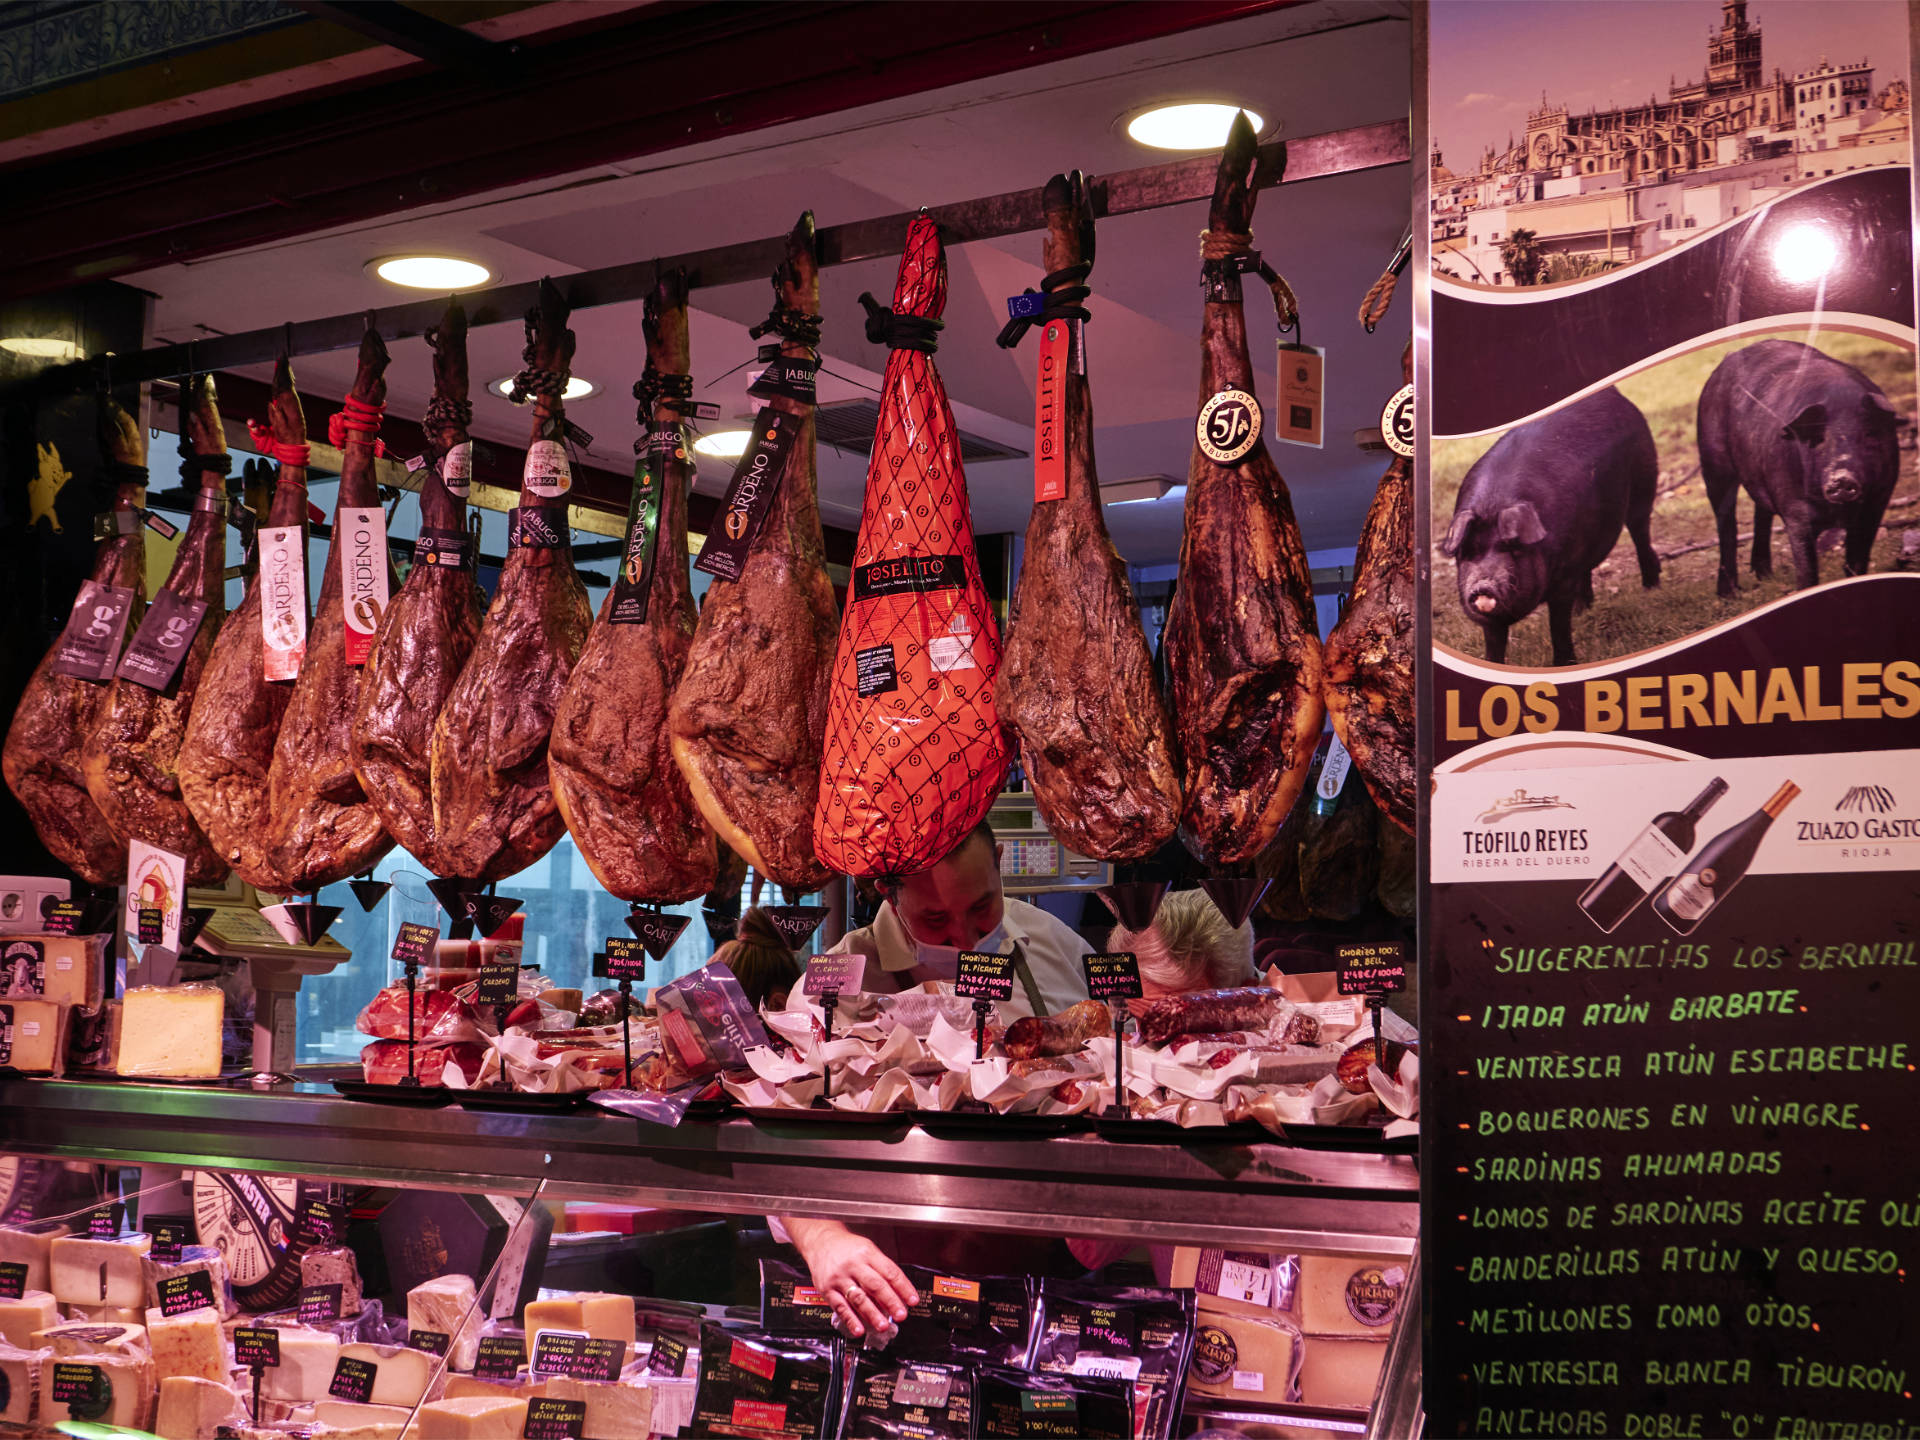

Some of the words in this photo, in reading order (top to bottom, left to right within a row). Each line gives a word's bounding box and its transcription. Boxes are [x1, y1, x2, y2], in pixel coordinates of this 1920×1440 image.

[1042, 355, 1054, 463] JOSELITO
[1200, 393, 1227, 426] CINCO
[1231, 391, 1258, 422] JOTAS
[1211, 406, 1245, 447] 5J
[1200, 436, 1239, 460] JABUGO
[728, 453, 769, 531] CARDENO
[523, 508, 560, 544] JABUGO
[627, 498, 649, 576] CARDENO
[354, 529, 375, 620] CARDENO
[866, 559, 945, 585] JOSELITO
[1445, 682, 1560, 742] LOS
[1584, 660, 1920, 733] BERNALES
[1463, 829, 1531, 854] TEÓFILO
[1536, 828, 1588, 851] REYES
[1797, 821, 1859, 840] ZUAZO
[1463, 858, 1509, 868] RIBERA
[1516, 857, 1540, 867] DEL
[1547, 855, 1591, 866] DUERO
[1841, 848, 1892, 858] RIOJA
[1734, 944, 1783, 969] LOS
[1583, 995, 1650, 1026] ATÚN
[1476, 1055, 1622, 1080] VENTRESCA
[1644, 1043, 1716, 1077] ATÚN
[1478, 1107, 1650, 1136] BOQUERONES
[1670, 1104, 1708, 1128] EN
[1473, 1152, 1603, 1182] SARDINAS
[1624, 1151, 1782, 1177] AHUMADAS
[1472, 1206, 1549, 1229] LOMOS
[1566, 1206, 1597, 1229] DE
[1611, 1195, 1744, 1226] SARDINAS
[1763, 1191, 1867, 1225] ACEITE
[1468, 1245, 1641, 1282] BANDERILLAS
[1661, 1241, 1742, 1273] ATÚN
[1763, 1247, 1780, 1273] Y
[1469, 1303, 1633, 1334] MEJILLONES
[1656, 1304, 1721, 1329] COMO
[1088, 1367, 1123, 1380] CECINA
[1473, 1360, 1620, 1386] VENTRESCA
[1645, 1359, 1752, 1386] BLANCA
[1475, 1408, 1608, 1436] ANCHOAS
[1625, 1413, 1703, 1439] DOBLE
